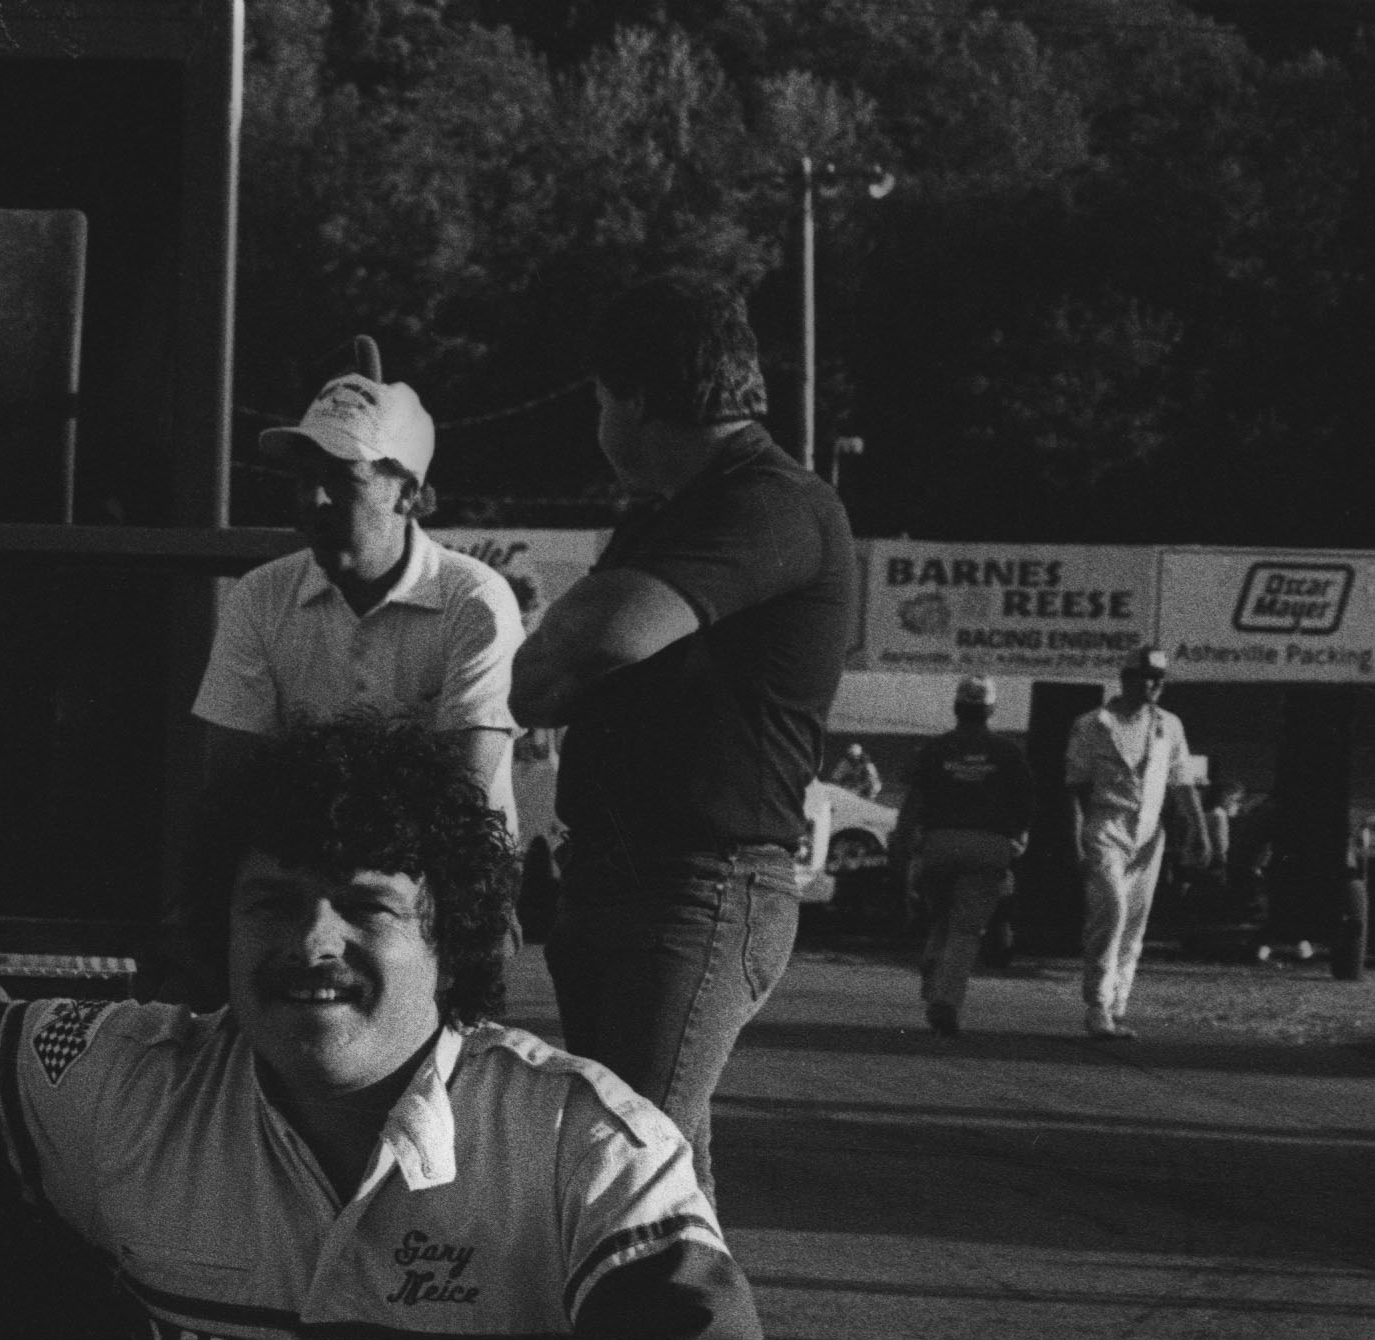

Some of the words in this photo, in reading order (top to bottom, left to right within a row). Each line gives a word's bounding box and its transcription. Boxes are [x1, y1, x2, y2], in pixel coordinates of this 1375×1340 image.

[886, 557, 1063, 588] BARNES
[1264, 573, 1335, 597] Oscar
[1002, 590, 1134, 619] REESE
[1252, 596, 1332, 622] Mayer
[956, 629, 1042, 650] RACING
[1175, 643, 1278, 665] Asheville
[1285, 643, 1374, 675] Packing
[394, 1229, 475, 1280] Gary
